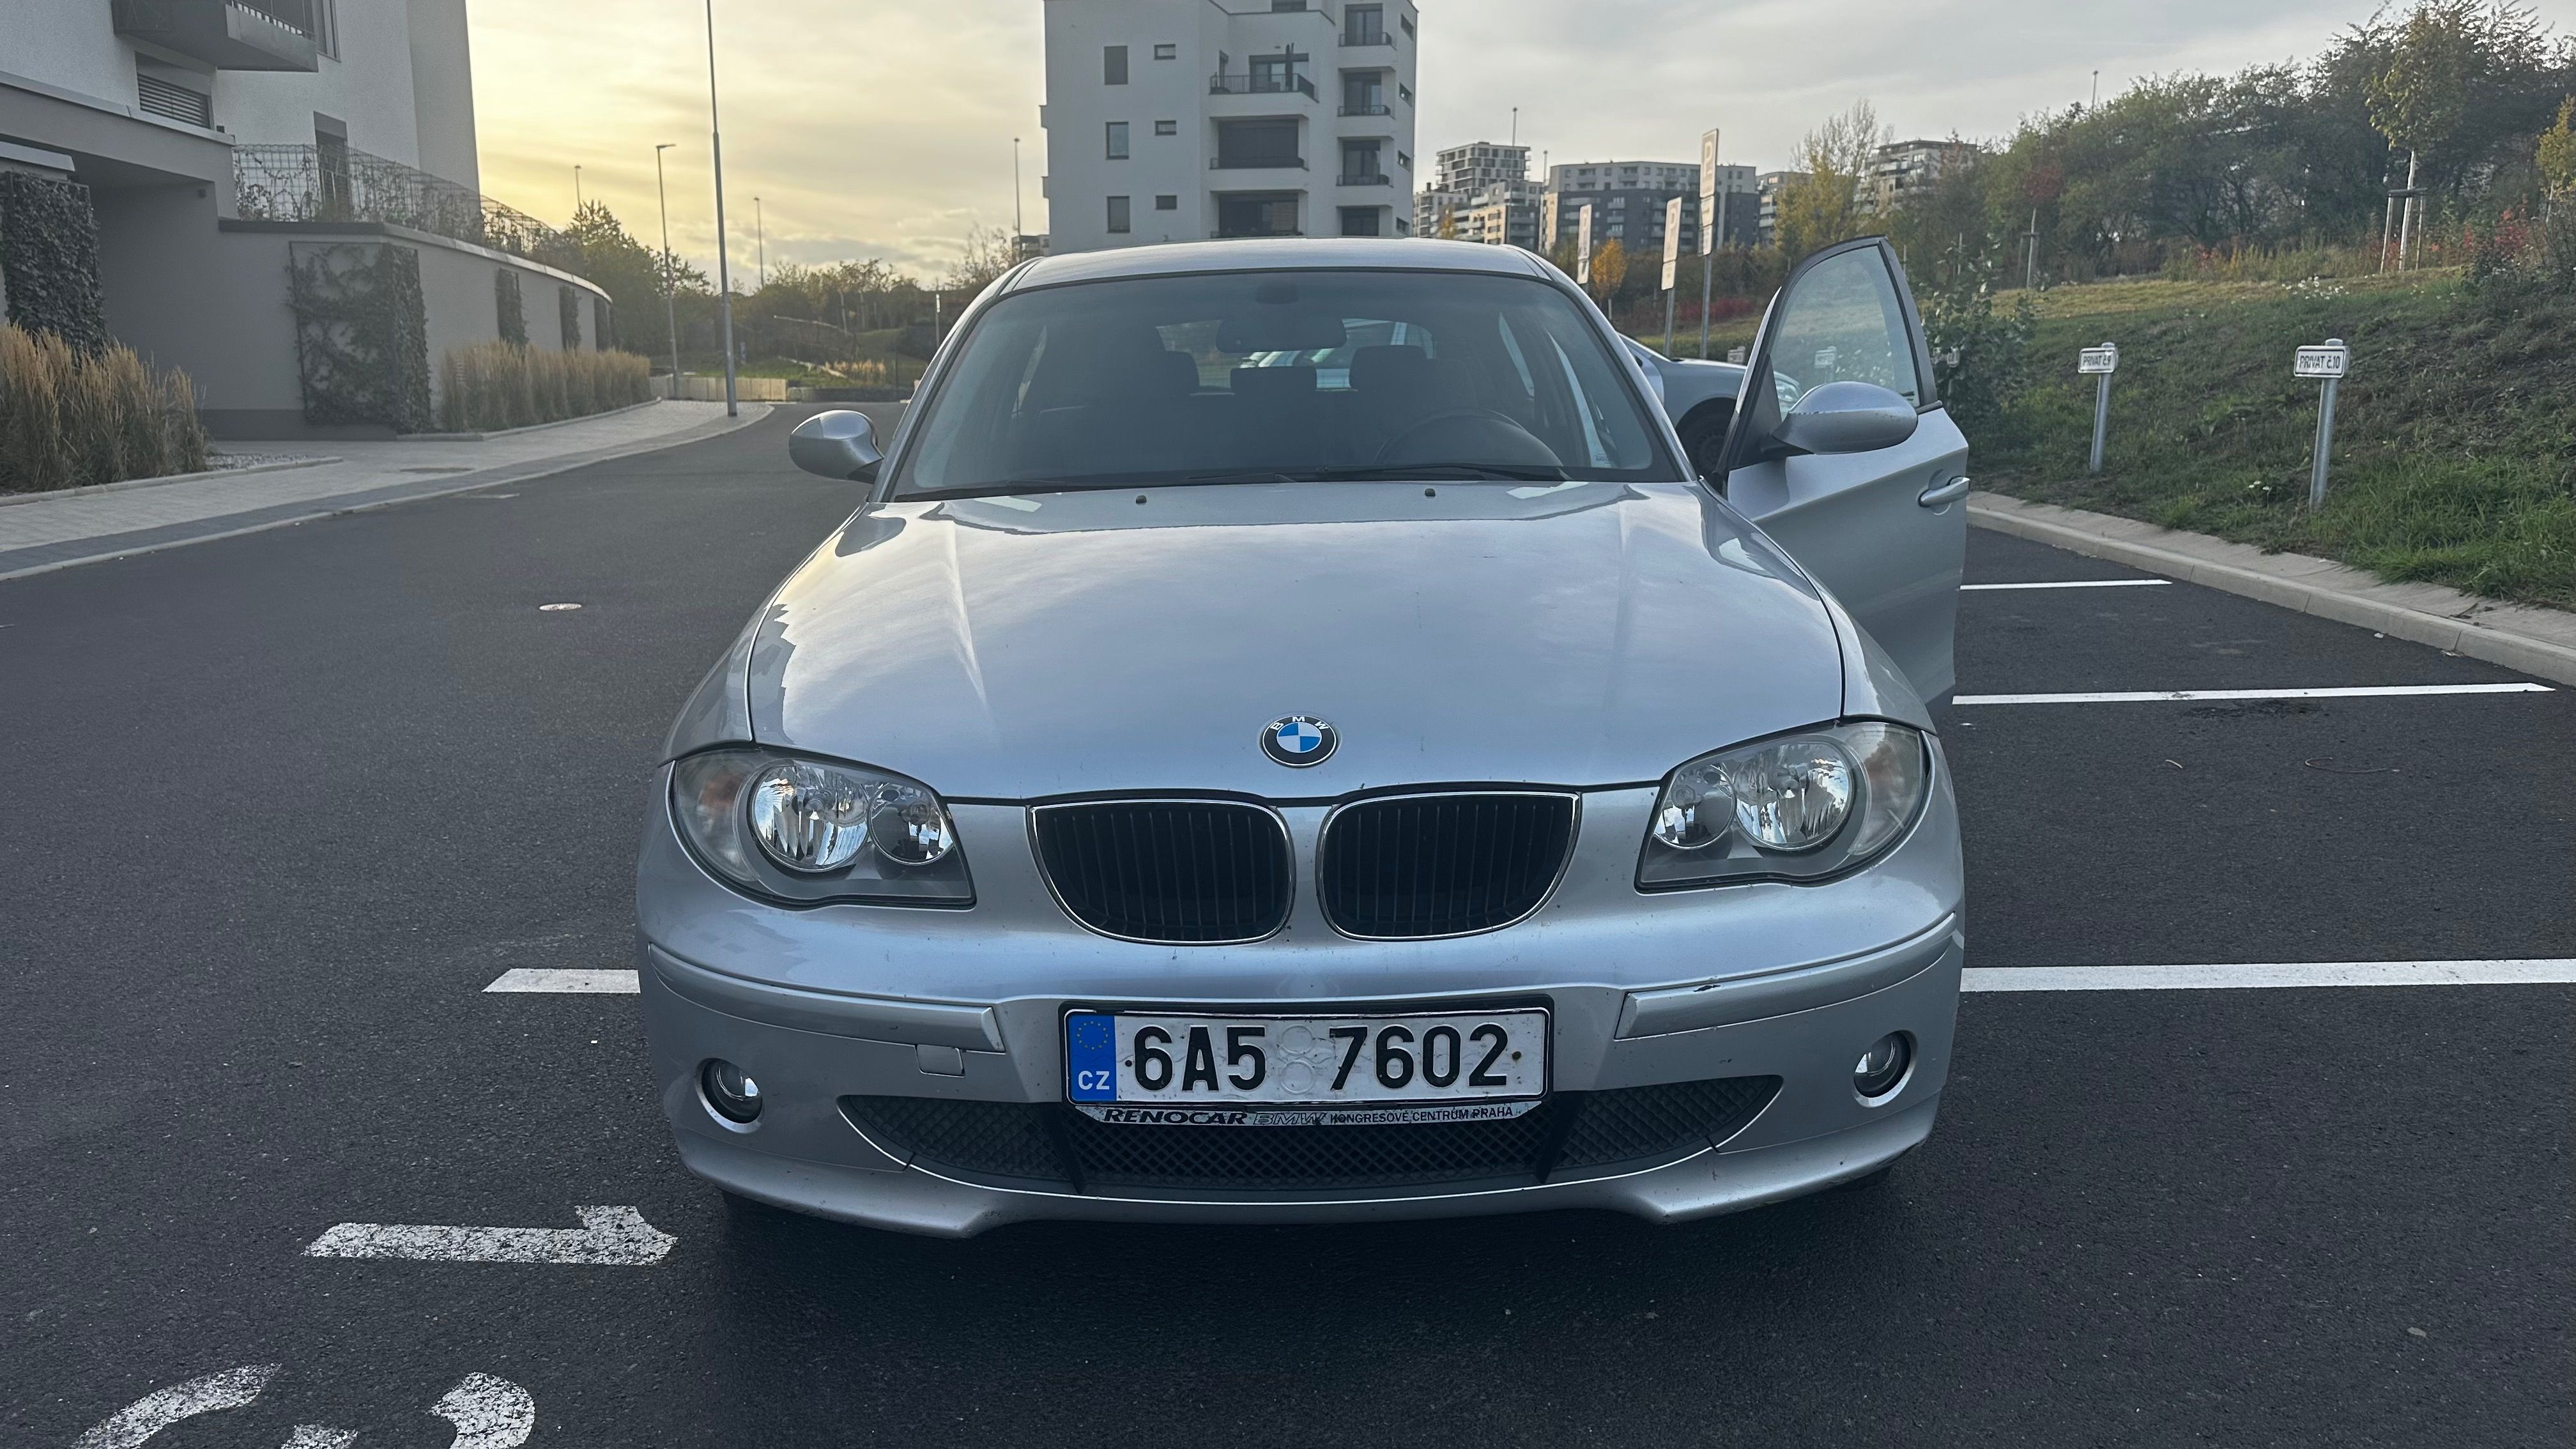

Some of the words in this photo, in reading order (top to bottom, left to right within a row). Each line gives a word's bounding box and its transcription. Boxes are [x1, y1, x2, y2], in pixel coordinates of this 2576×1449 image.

[1704, 141, 1713, 178] P
[2083, 355, 2101, 366] PRIVAT
[2299, 355, 2326, 369] PRIVAT
[2327, 355, 2340, 369] č.10
[1270, 716, 1330, 731] BMW
[1133, 1025, 1266, 1092] 6A5
[1329, 1023, 1508, 1092] 7602
[1078, 1070, 1110, 1091] CZ
[1103, 1108, 1247, 1125] RENOCAR
[1252, 1112, 1327, 1125] BMW
[1412, 1108, 1469, 1121] CENTRUM
[1471, 1106, 1514, 1119] PRAHA
